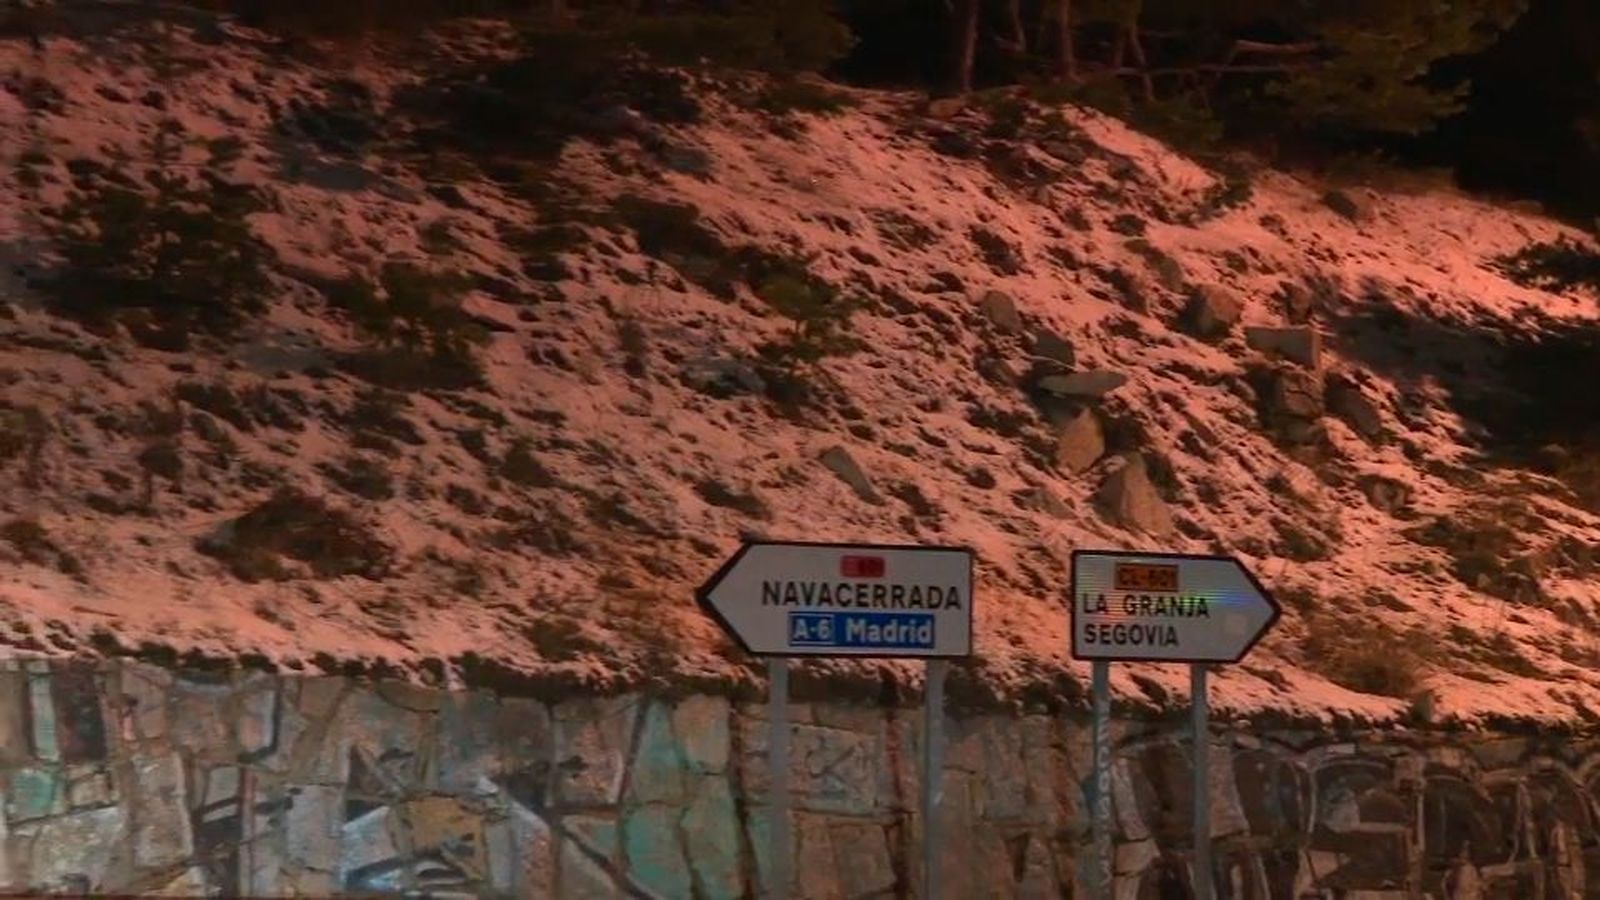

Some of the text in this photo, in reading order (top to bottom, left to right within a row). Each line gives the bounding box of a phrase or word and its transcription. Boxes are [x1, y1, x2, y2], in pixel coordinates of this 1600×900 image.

[762, 581, 962, 610] NAVACERRADA
[1083, 593, 1210, 619] LA GRANJA
[793, 617, 932, 644] A-6 Madrid
[1084, 623, 1180, 647] SEGOVIA
